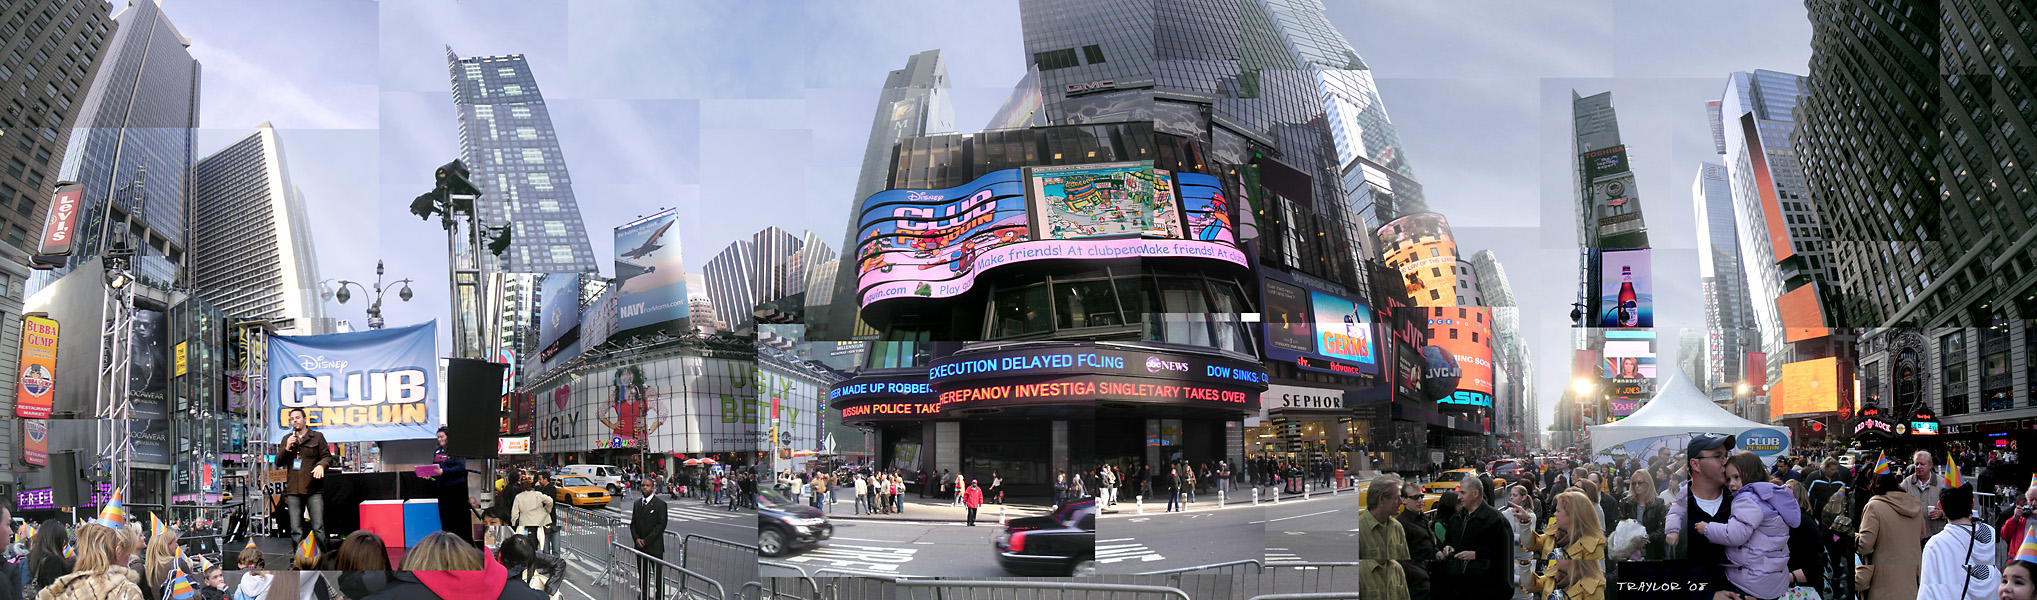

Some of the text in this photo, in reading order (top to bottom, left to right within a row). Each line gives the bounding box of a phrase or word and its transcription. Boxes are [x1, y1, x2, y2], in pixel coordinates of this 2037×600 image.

[1066, 80, 1115, 92] GMC
[1585, 146, 1624, 158] TOSHIBA
[893, 190, 997, 230] CLUB
[1600, 212, 1640, 225] CHEVROLET
[978, 255, 1005, 271] Make
[1008, 245, 1063, 264] friends!
[1067, 245, 1083, 256] At
[1142, 244, 1169, 255] Make
[1174, 245, 1214, 256] friends!
[940, 285, 961, 296] Play
[1291, 272, 1346, 297] WRIGLEY'S
[27, 320, 56, 336] BUBBA
[28, 333, 54, 347] GUMP
[1323, 331, 1368, 358] GERMS
[1402, 320, 1423, 354] JVC
[929, 359, 997, 380] EXECUTION
[1001, 354, 1073, 371] DELAYED
[1162, 361, 1188, 372] NEWS
[1207, 365, 1230, 378] DOW
[1232, 369, 1259, 383] SINKS:
[1330, 361, 1359, 374] Advance
[1426, 368, 1449, 379] JVC
[280, 369, 426, 408] CLUB
[728, 363, 793, 400] UGLY
[842, 384, 867, 396] MADE
[870, 383, 885, 393] UP
[1015, 382, 1095, 398] INVESTIGA
[1099, 382, 1246, 404] SINGLETARY TAKES OVER
[280, 402, 426, 428] PENGUIN
[720, 394, 799, 428] BETTY
[873, 404, 912, 414] POLICE
[540, 411, 579, 441] UGLY
[1874, 420, 1891, 432] ROCK
